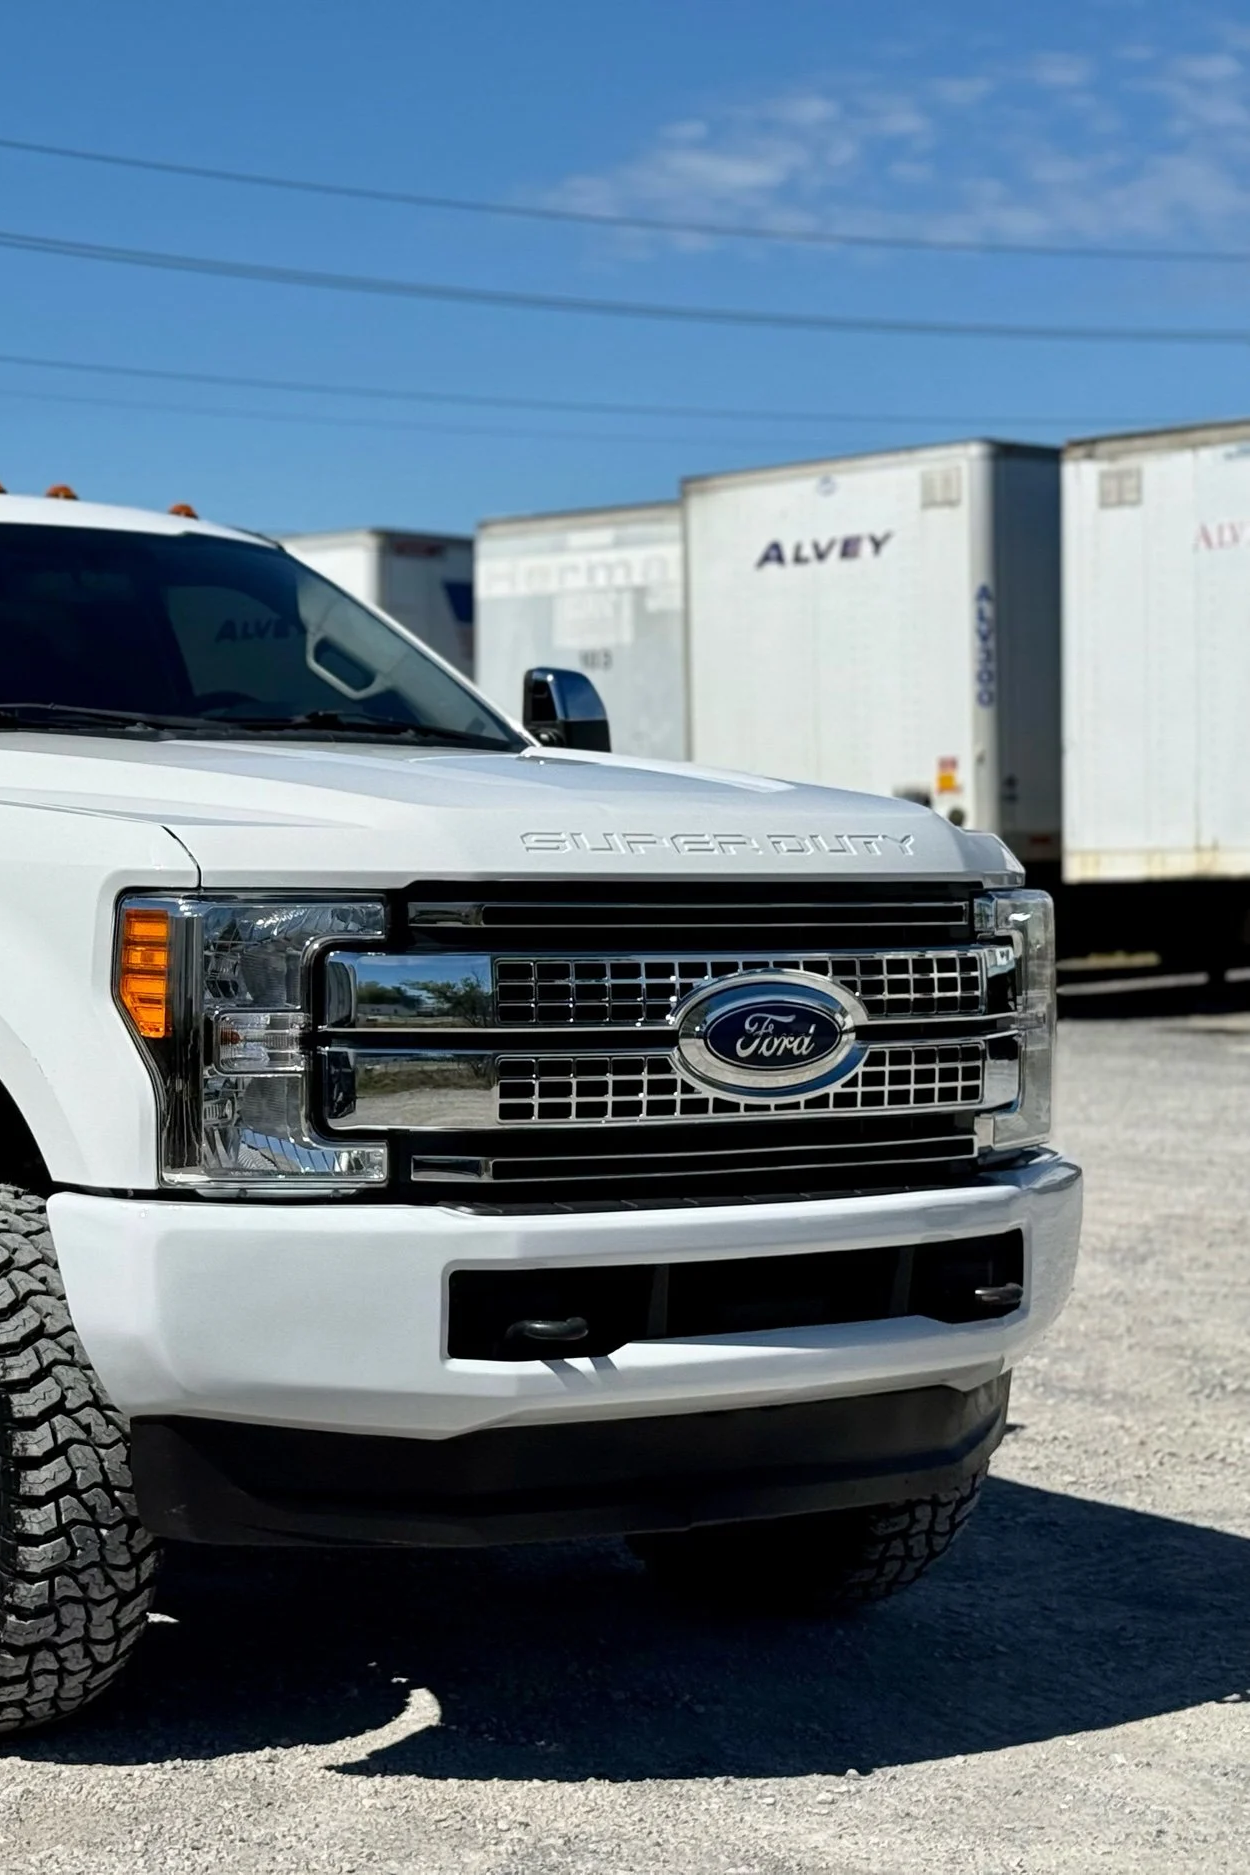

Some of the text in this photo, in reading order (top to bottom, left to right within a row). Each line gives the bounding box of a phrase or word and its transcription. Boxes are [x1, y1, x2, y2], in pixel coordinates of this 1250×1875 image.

[755, 530, 894, 571] ALVEY
[1192, 519, 1250, 555] ALV
[519, 831, 915, 857] SUPER DUTY
[735, 1012, 817, 1058] Ford
